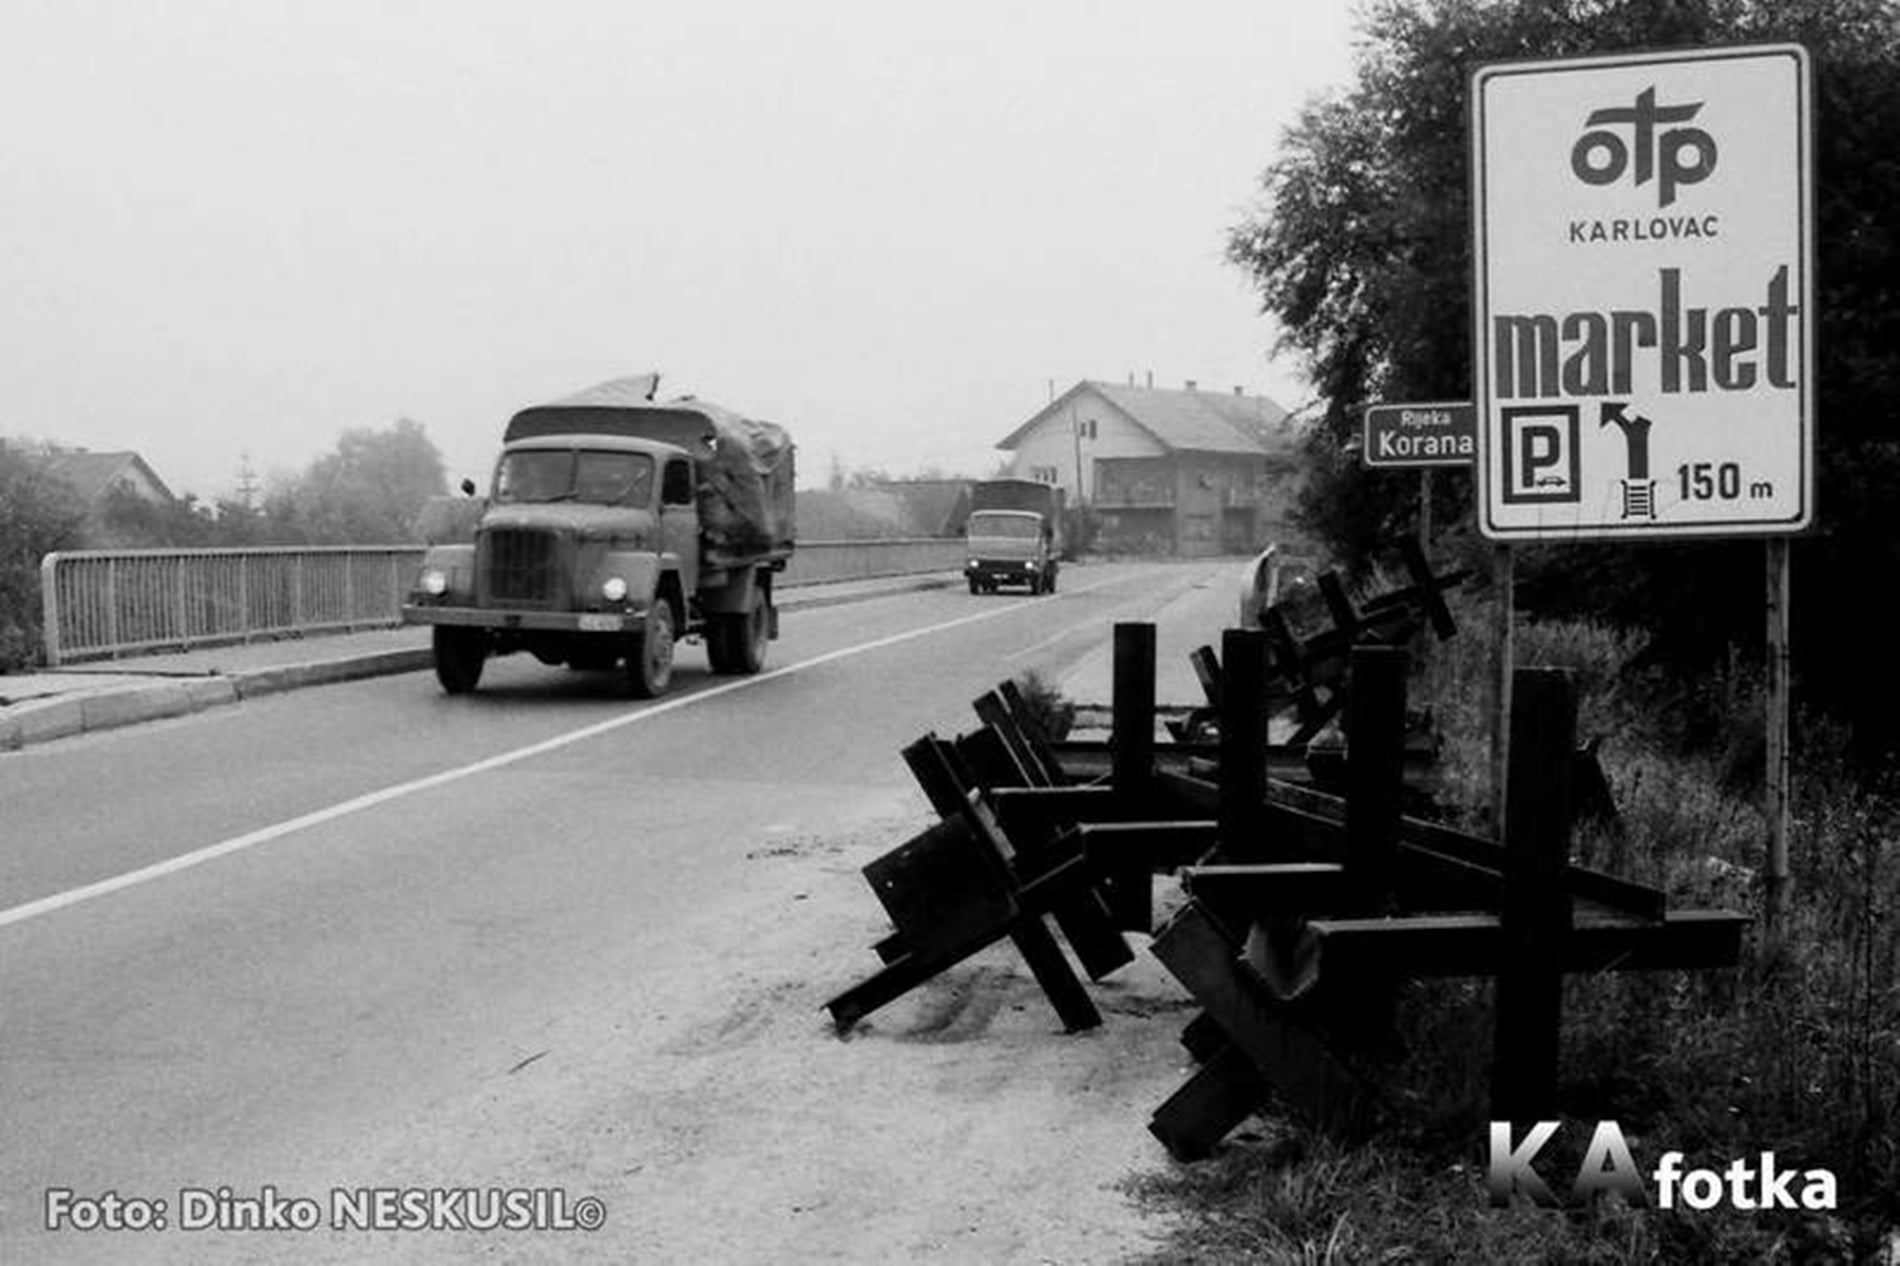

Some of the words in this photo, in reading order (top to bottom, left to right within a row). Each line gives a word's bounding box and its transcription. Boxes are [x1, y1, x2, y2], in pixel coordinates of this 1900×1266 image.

[1569, 216, 1718, 243] KARLOVAC
[1494, 264, 1798, 398] market
[1401, 409, 1451, 429] Rijeka
[1379, 430, 1473, 456] Korana
[1521, 425, 1560, 488] P
[1677, 463, 1740, 500] 150
[1750, 480, 1772, 499] m
